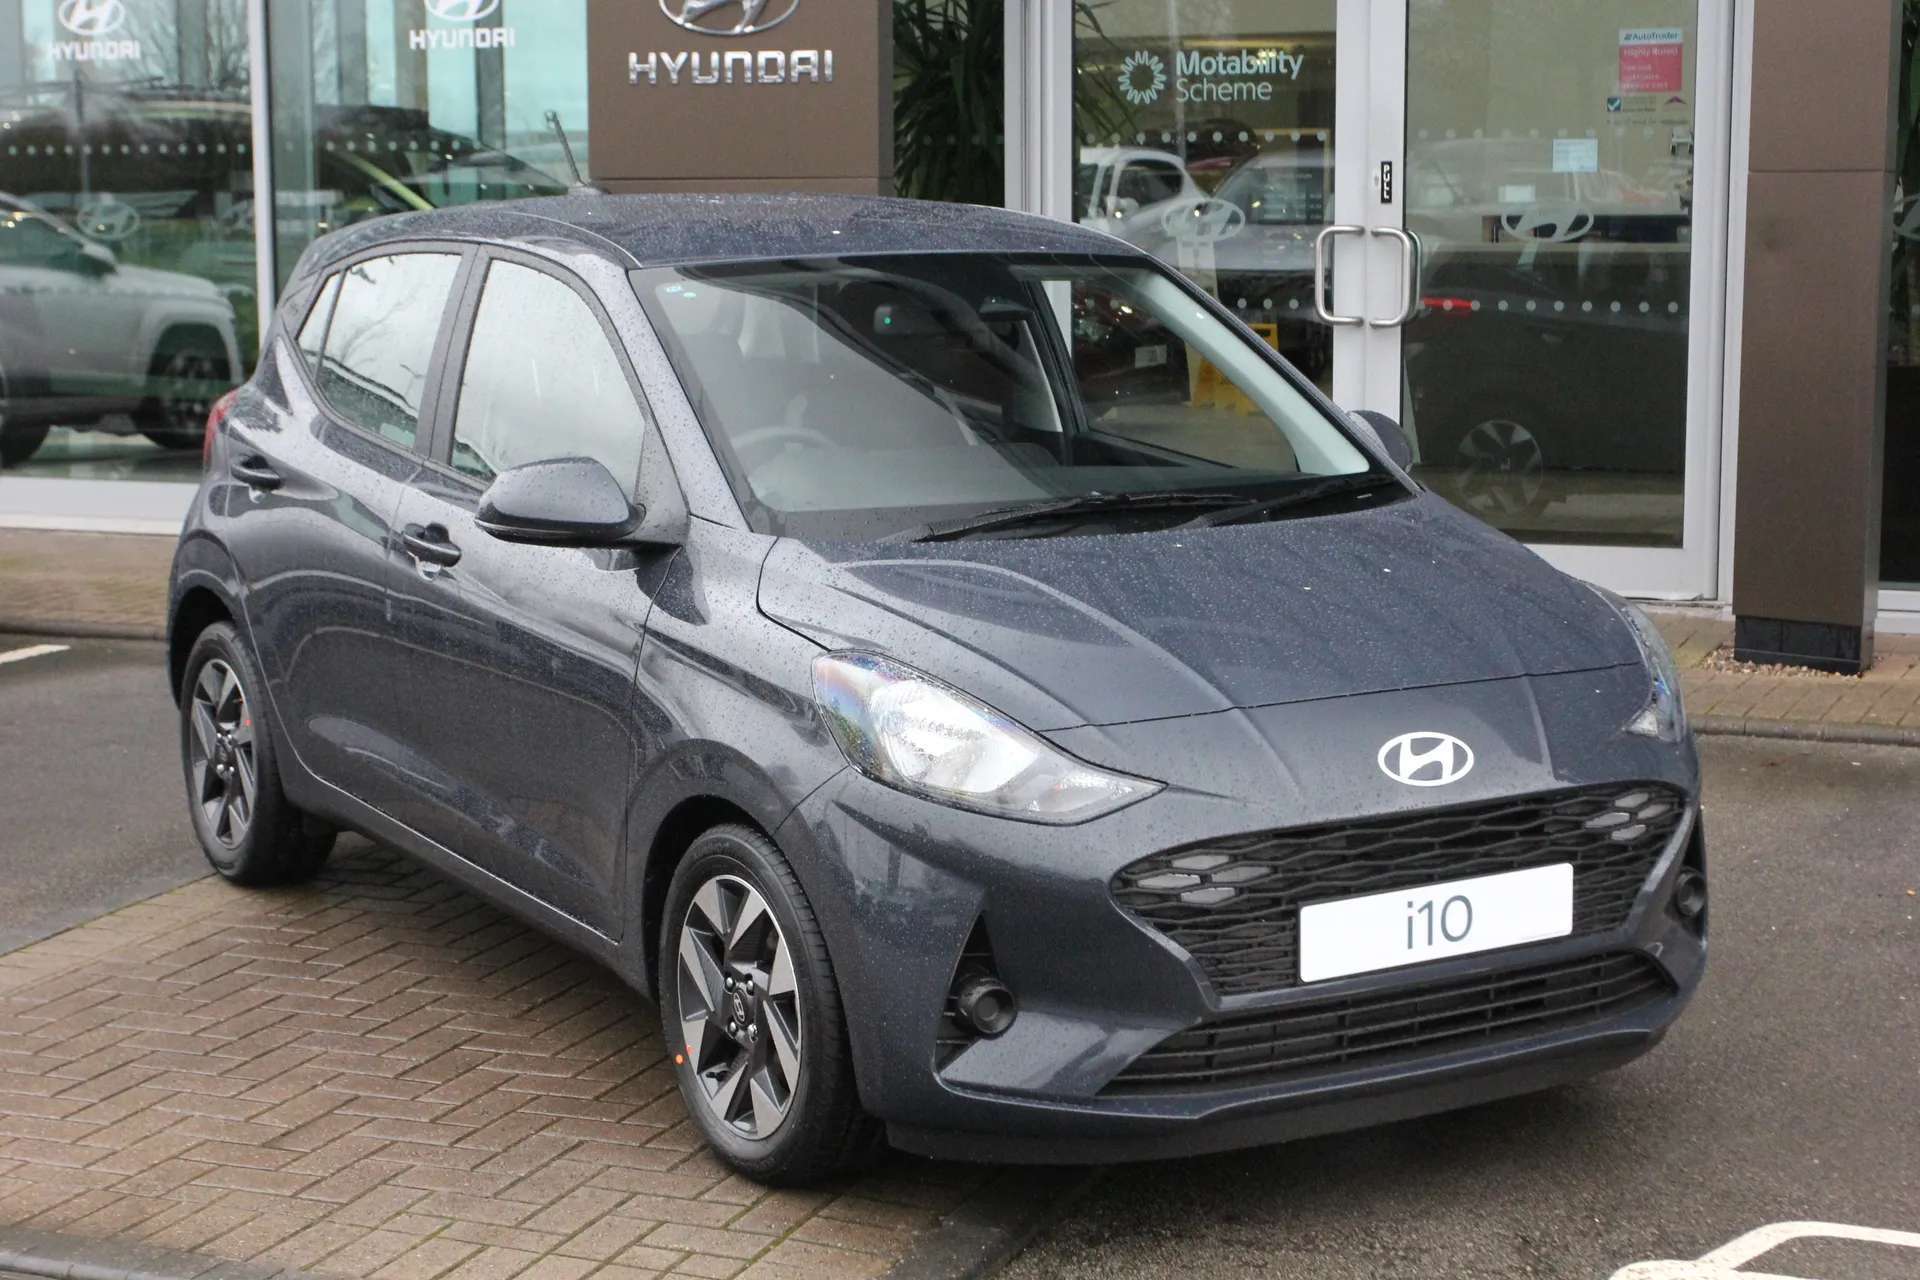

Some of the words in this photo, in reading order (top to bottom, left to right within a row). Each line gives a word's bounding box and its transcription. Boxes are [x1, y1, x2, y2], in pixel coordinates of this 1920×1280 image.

[48, 40, 141, 60] HYUNDAI
[409, 27, 516, 50] HYUNDAI
[628, 50, 833, 84] HYUNDAI
[1175, 49, 1304, 80] Motability
[1175, 77, 1273, 102] Scheme
[1383, 164, 1391, 200] PULL
[1406, 894, 1473, 950] i10
